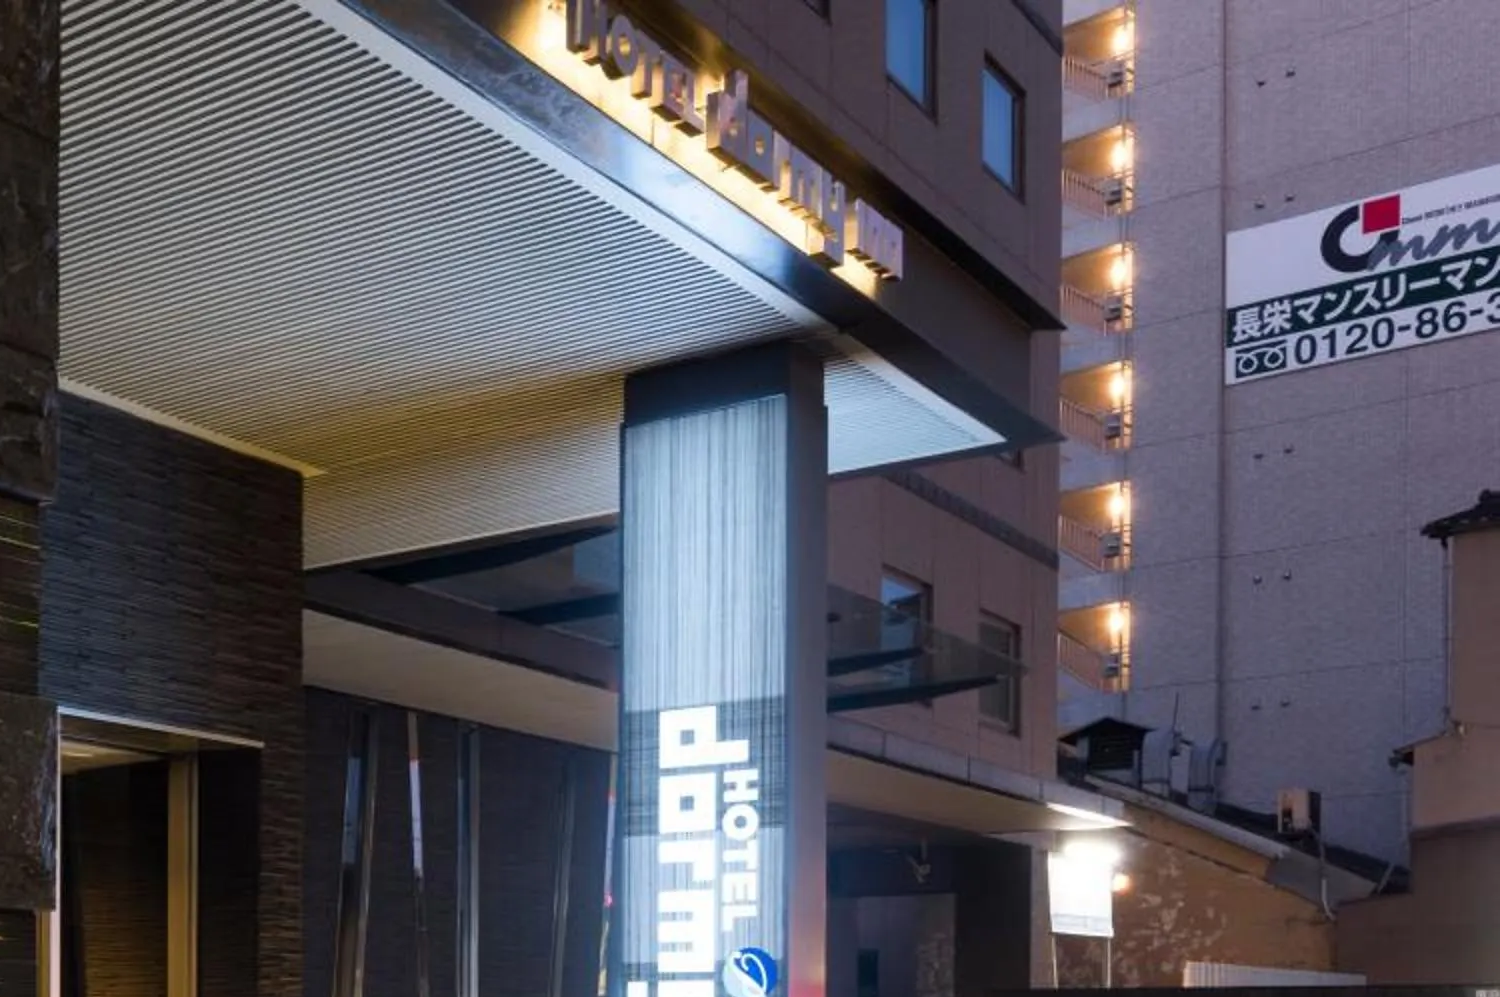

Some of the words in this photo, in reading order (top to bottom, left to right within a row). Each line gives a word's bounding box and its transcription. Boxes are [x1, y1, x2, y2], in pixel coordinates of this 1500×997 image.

[707, 68, 846, 267] dormy
[845, 197, 904, 281] inn
[1232, 253, 1500, 344] 長栄マンスリーマン
[722, 768, 759, 932] HOTEL
